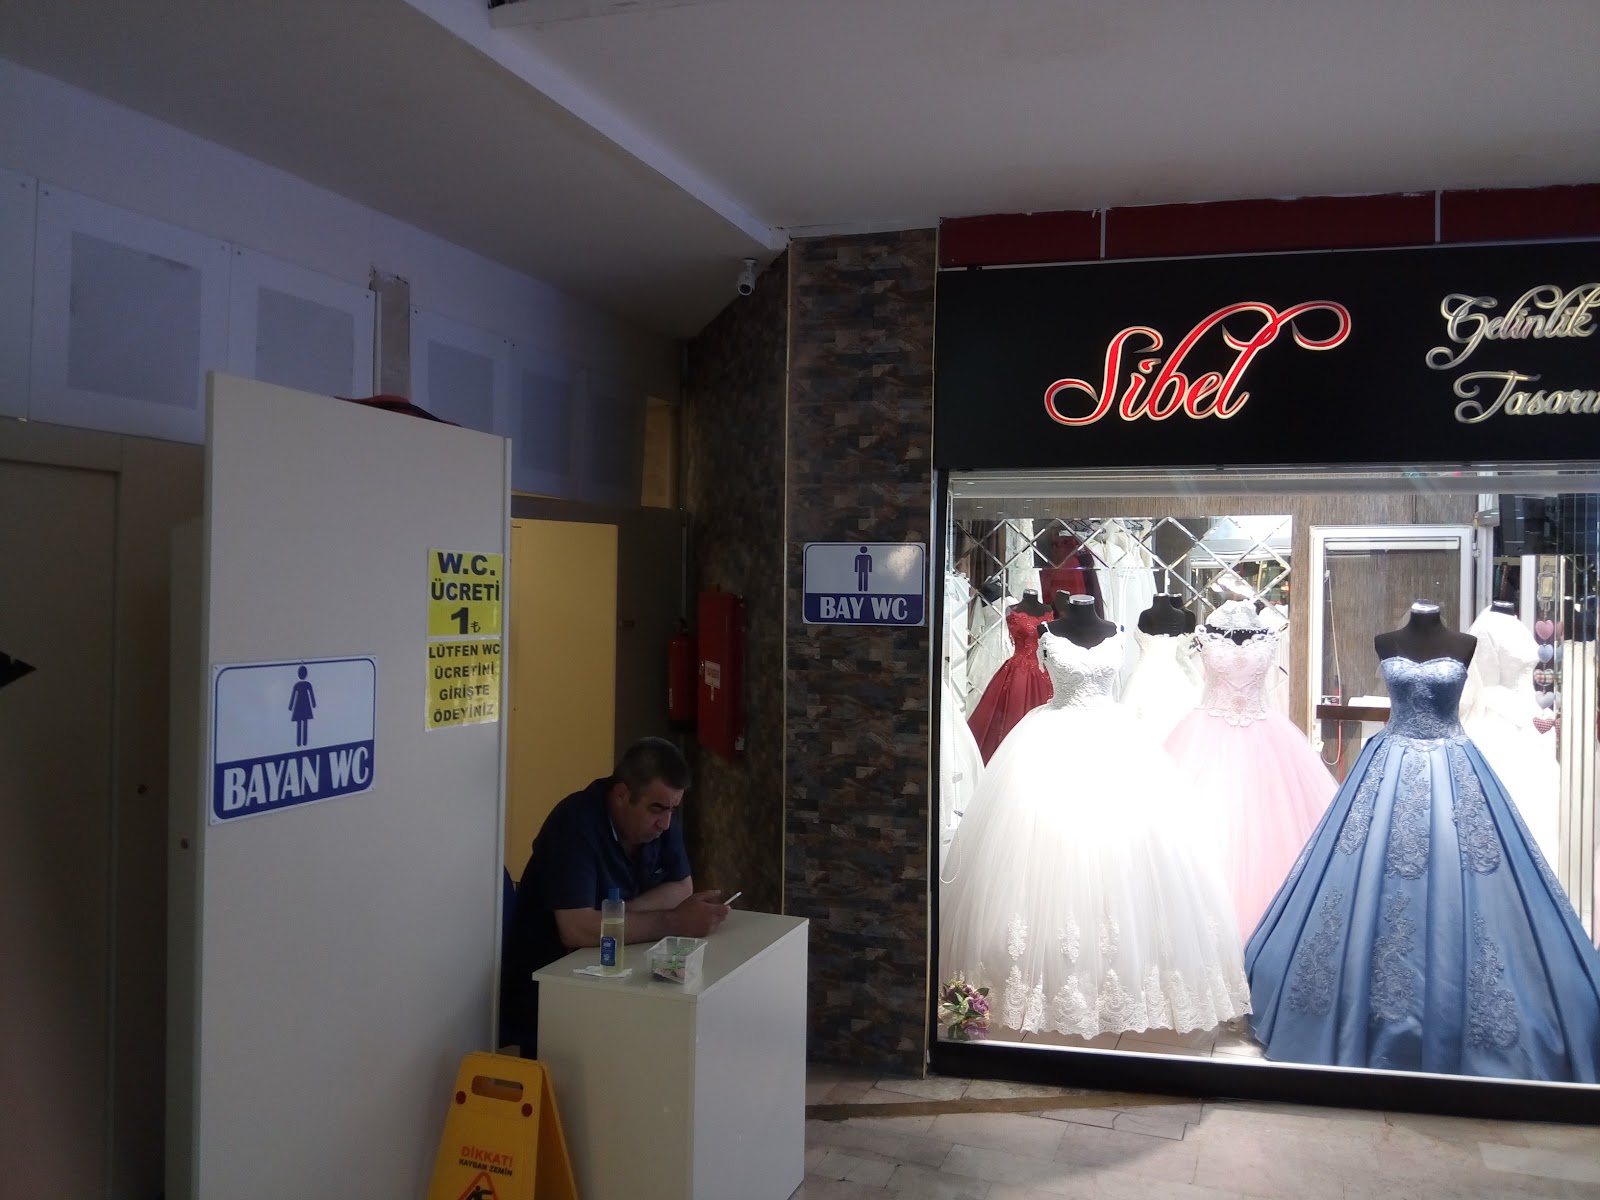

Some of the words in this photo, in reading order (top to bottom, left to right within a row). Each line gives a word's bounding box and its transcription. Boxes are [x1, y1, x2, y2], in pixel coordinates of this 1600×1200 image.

[1044, 300, 1352, 426] Sibel
[1453, 370, 1600, 424] Tasarı
[438, 552, 496, 575] W.C.
[431, 578, 500, 601] ÜCRETİ
[819, 596, 864, 619] BAY
[871, 597, 908, 621] WC
[428, 644, 479, 659] LÜTFEN
[482, 643, 500, 656] WC
[434, 661, 495, 680] ÜCRETİNİ
[439, 684, 490, 701] GİRİŞTE
[433, 704, 494, 723] ÖDEYİNİZ
[223, 754, 321, 812] BAYAN
[328, 746, 370, 789] WC
